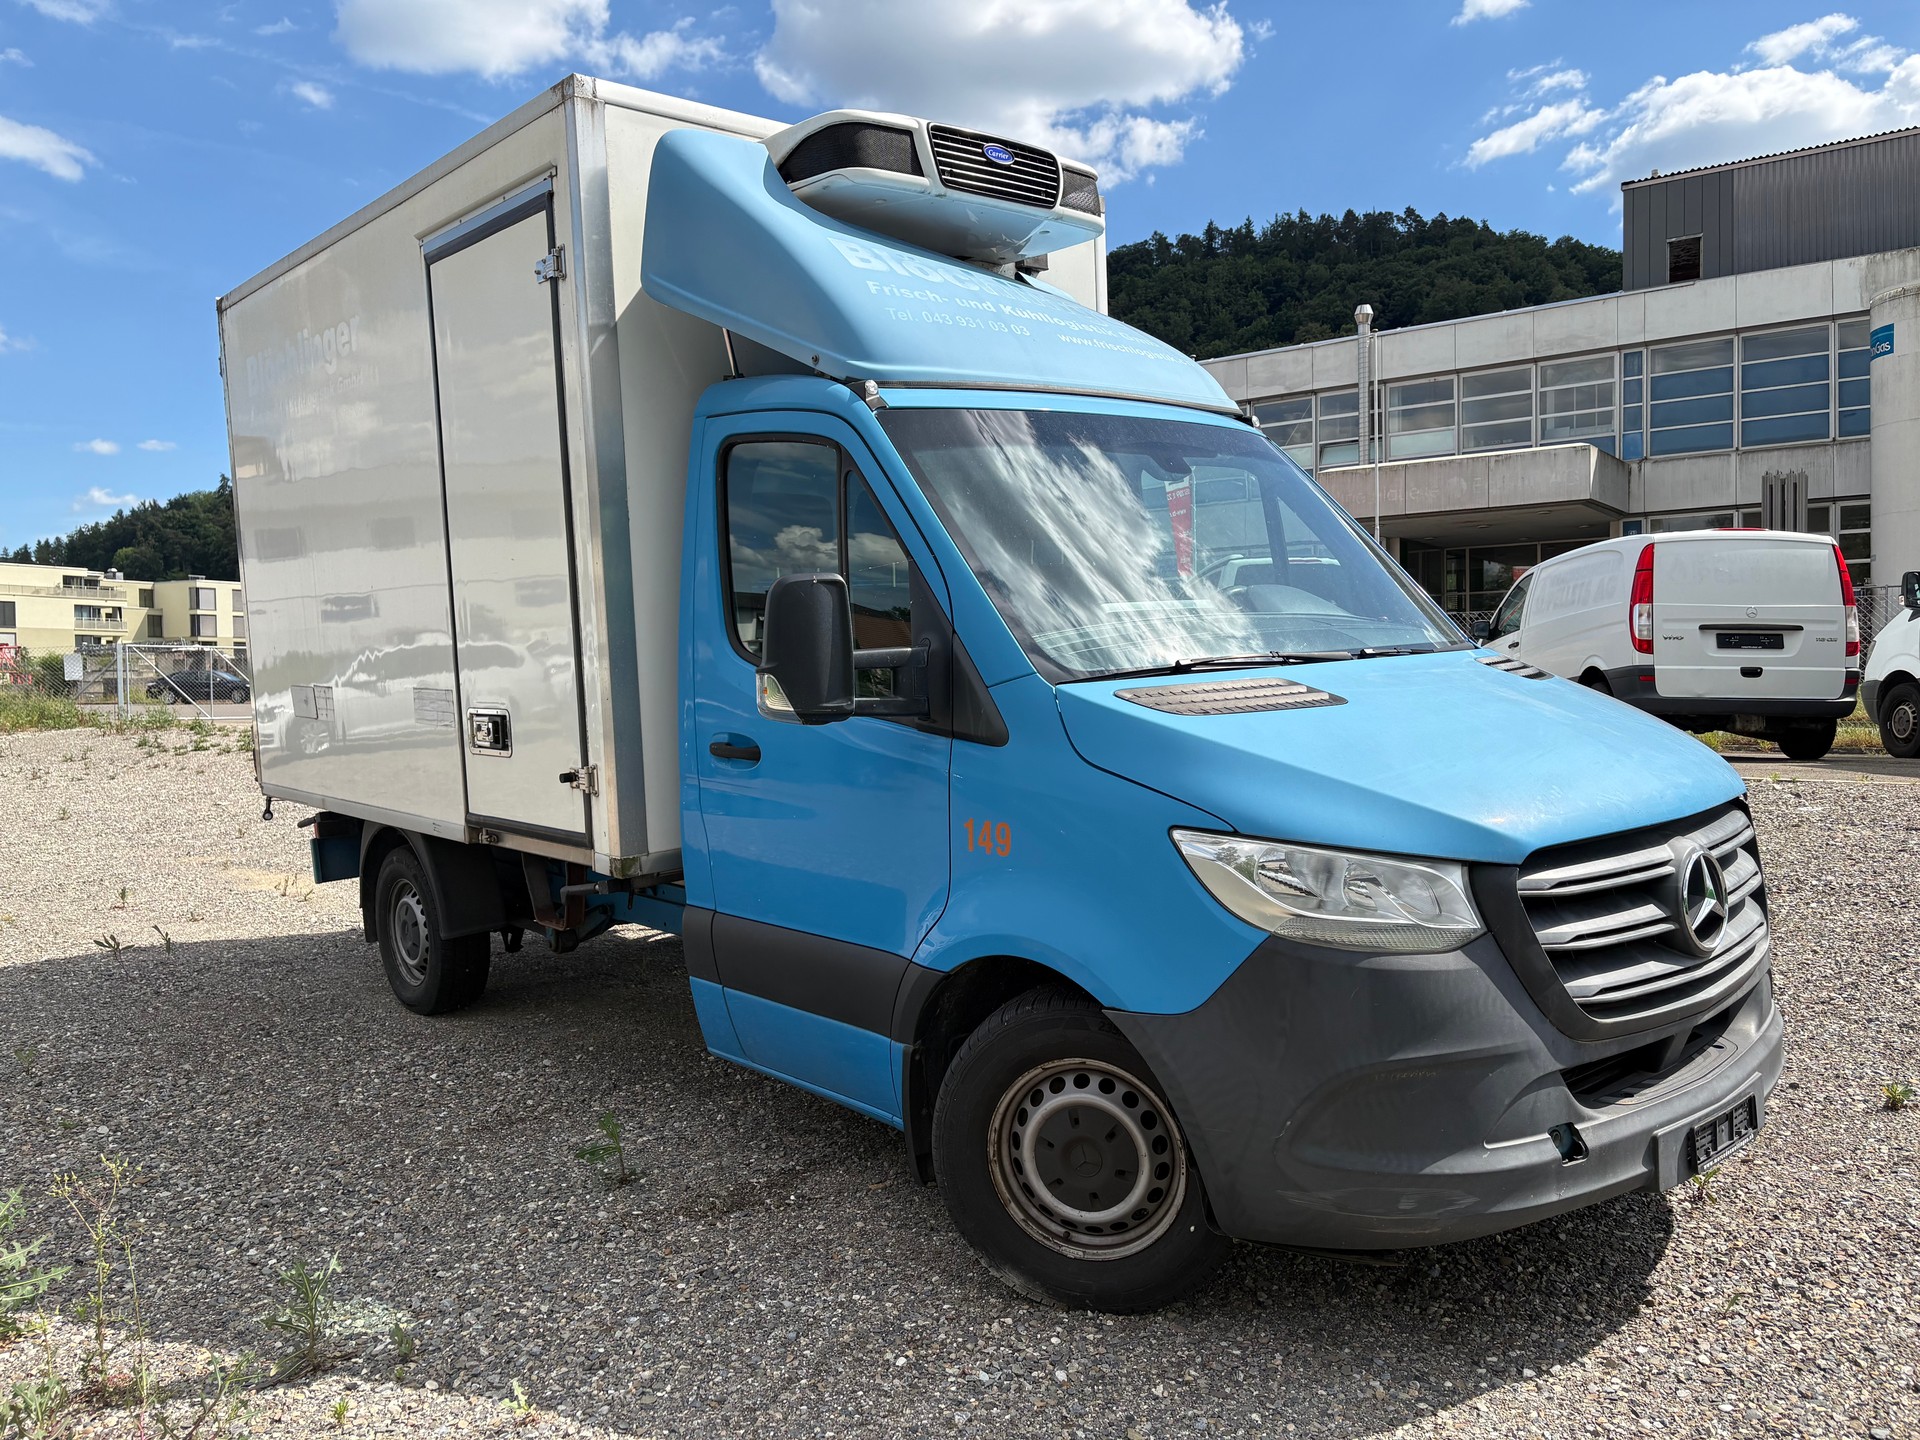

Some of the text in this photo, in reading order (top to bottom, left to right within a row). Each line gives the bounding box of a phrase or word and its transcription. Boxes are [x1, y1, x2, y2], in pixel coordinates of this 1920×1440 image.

[987, 149, 1009, 160] Carrier
[866, 280, 949, 303] Frisch-
[955, 298, 997, 313] und
[999, 303, 1118, 337] Kühllogistik
[884, 307, 1031, 337] Tel. 043 931 03 03
[963, 817, 1012, 858] 149
